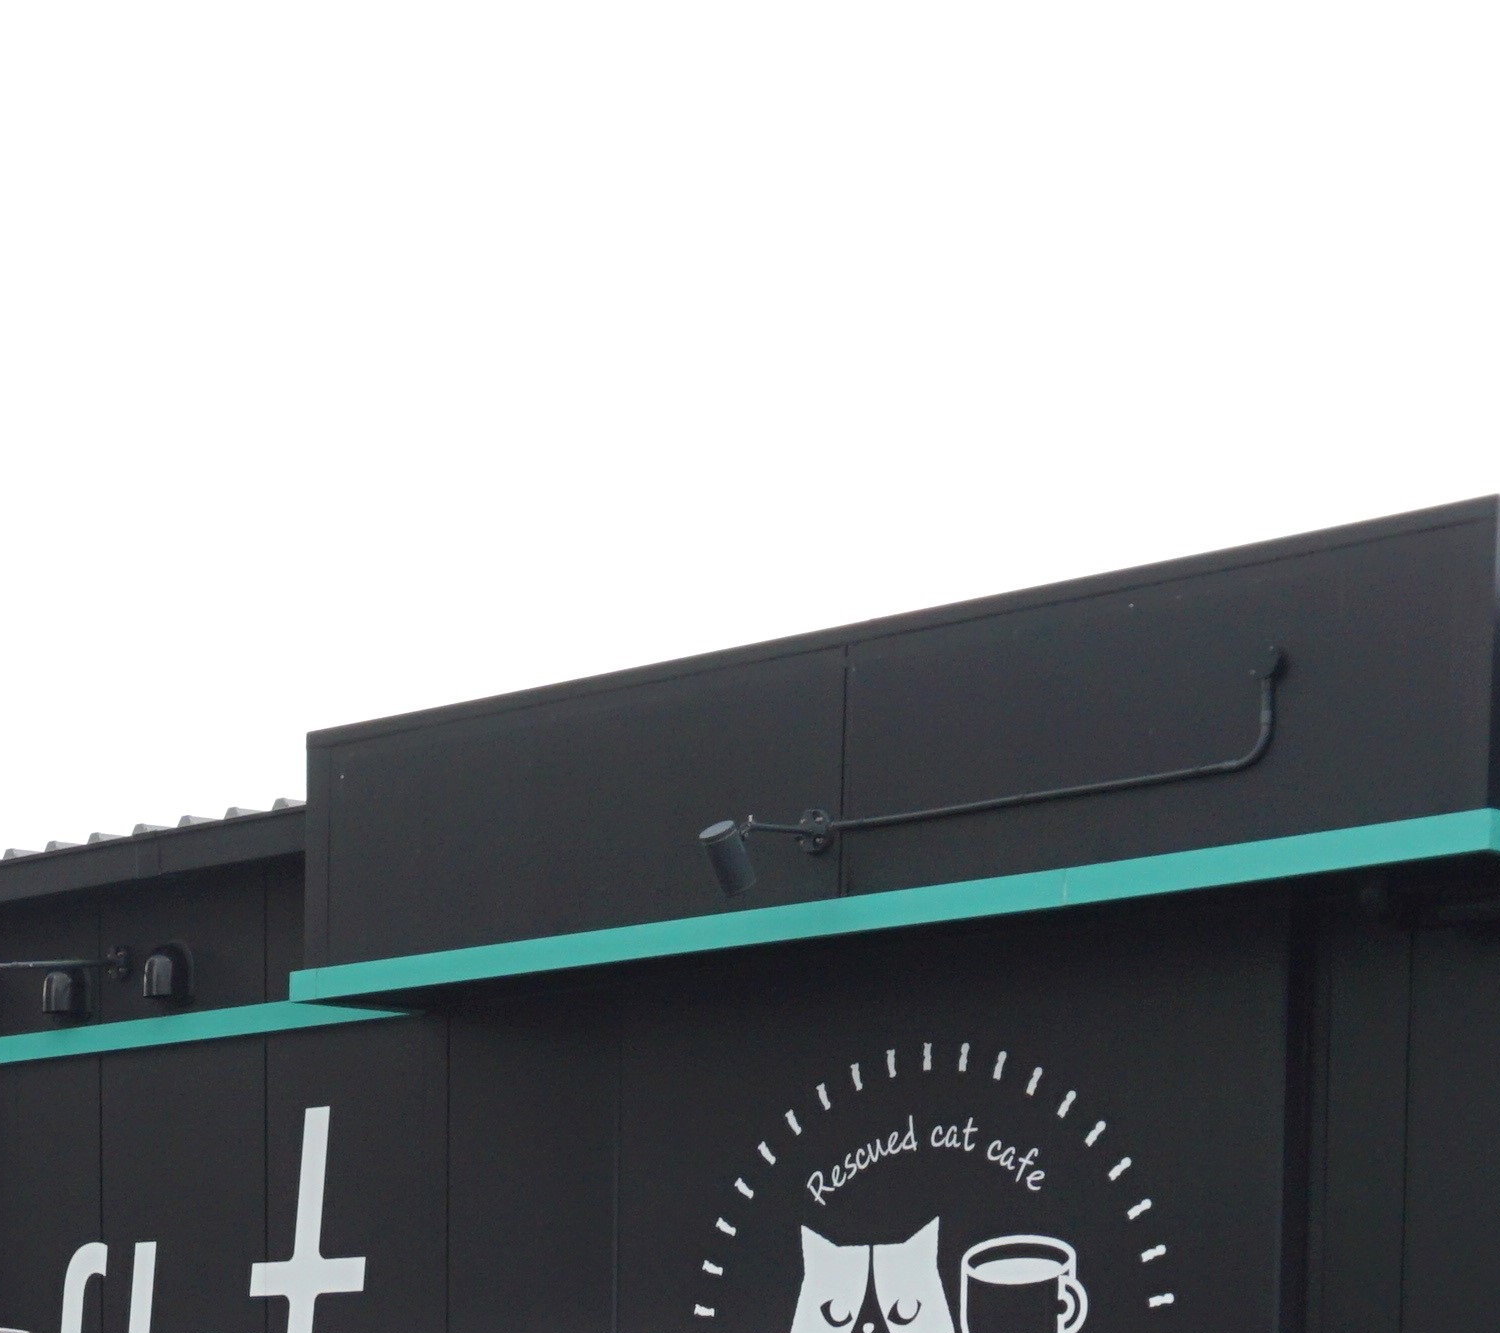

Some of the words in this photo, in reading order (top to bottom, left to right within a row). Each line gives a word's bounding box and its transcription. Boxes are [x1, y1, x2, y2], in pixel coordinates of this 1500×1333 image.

[806, 1114, 918, 1206] Rescued
[930, 1116, 979, 1151] cat
[987, 1139, 1046, 1191] cafe
